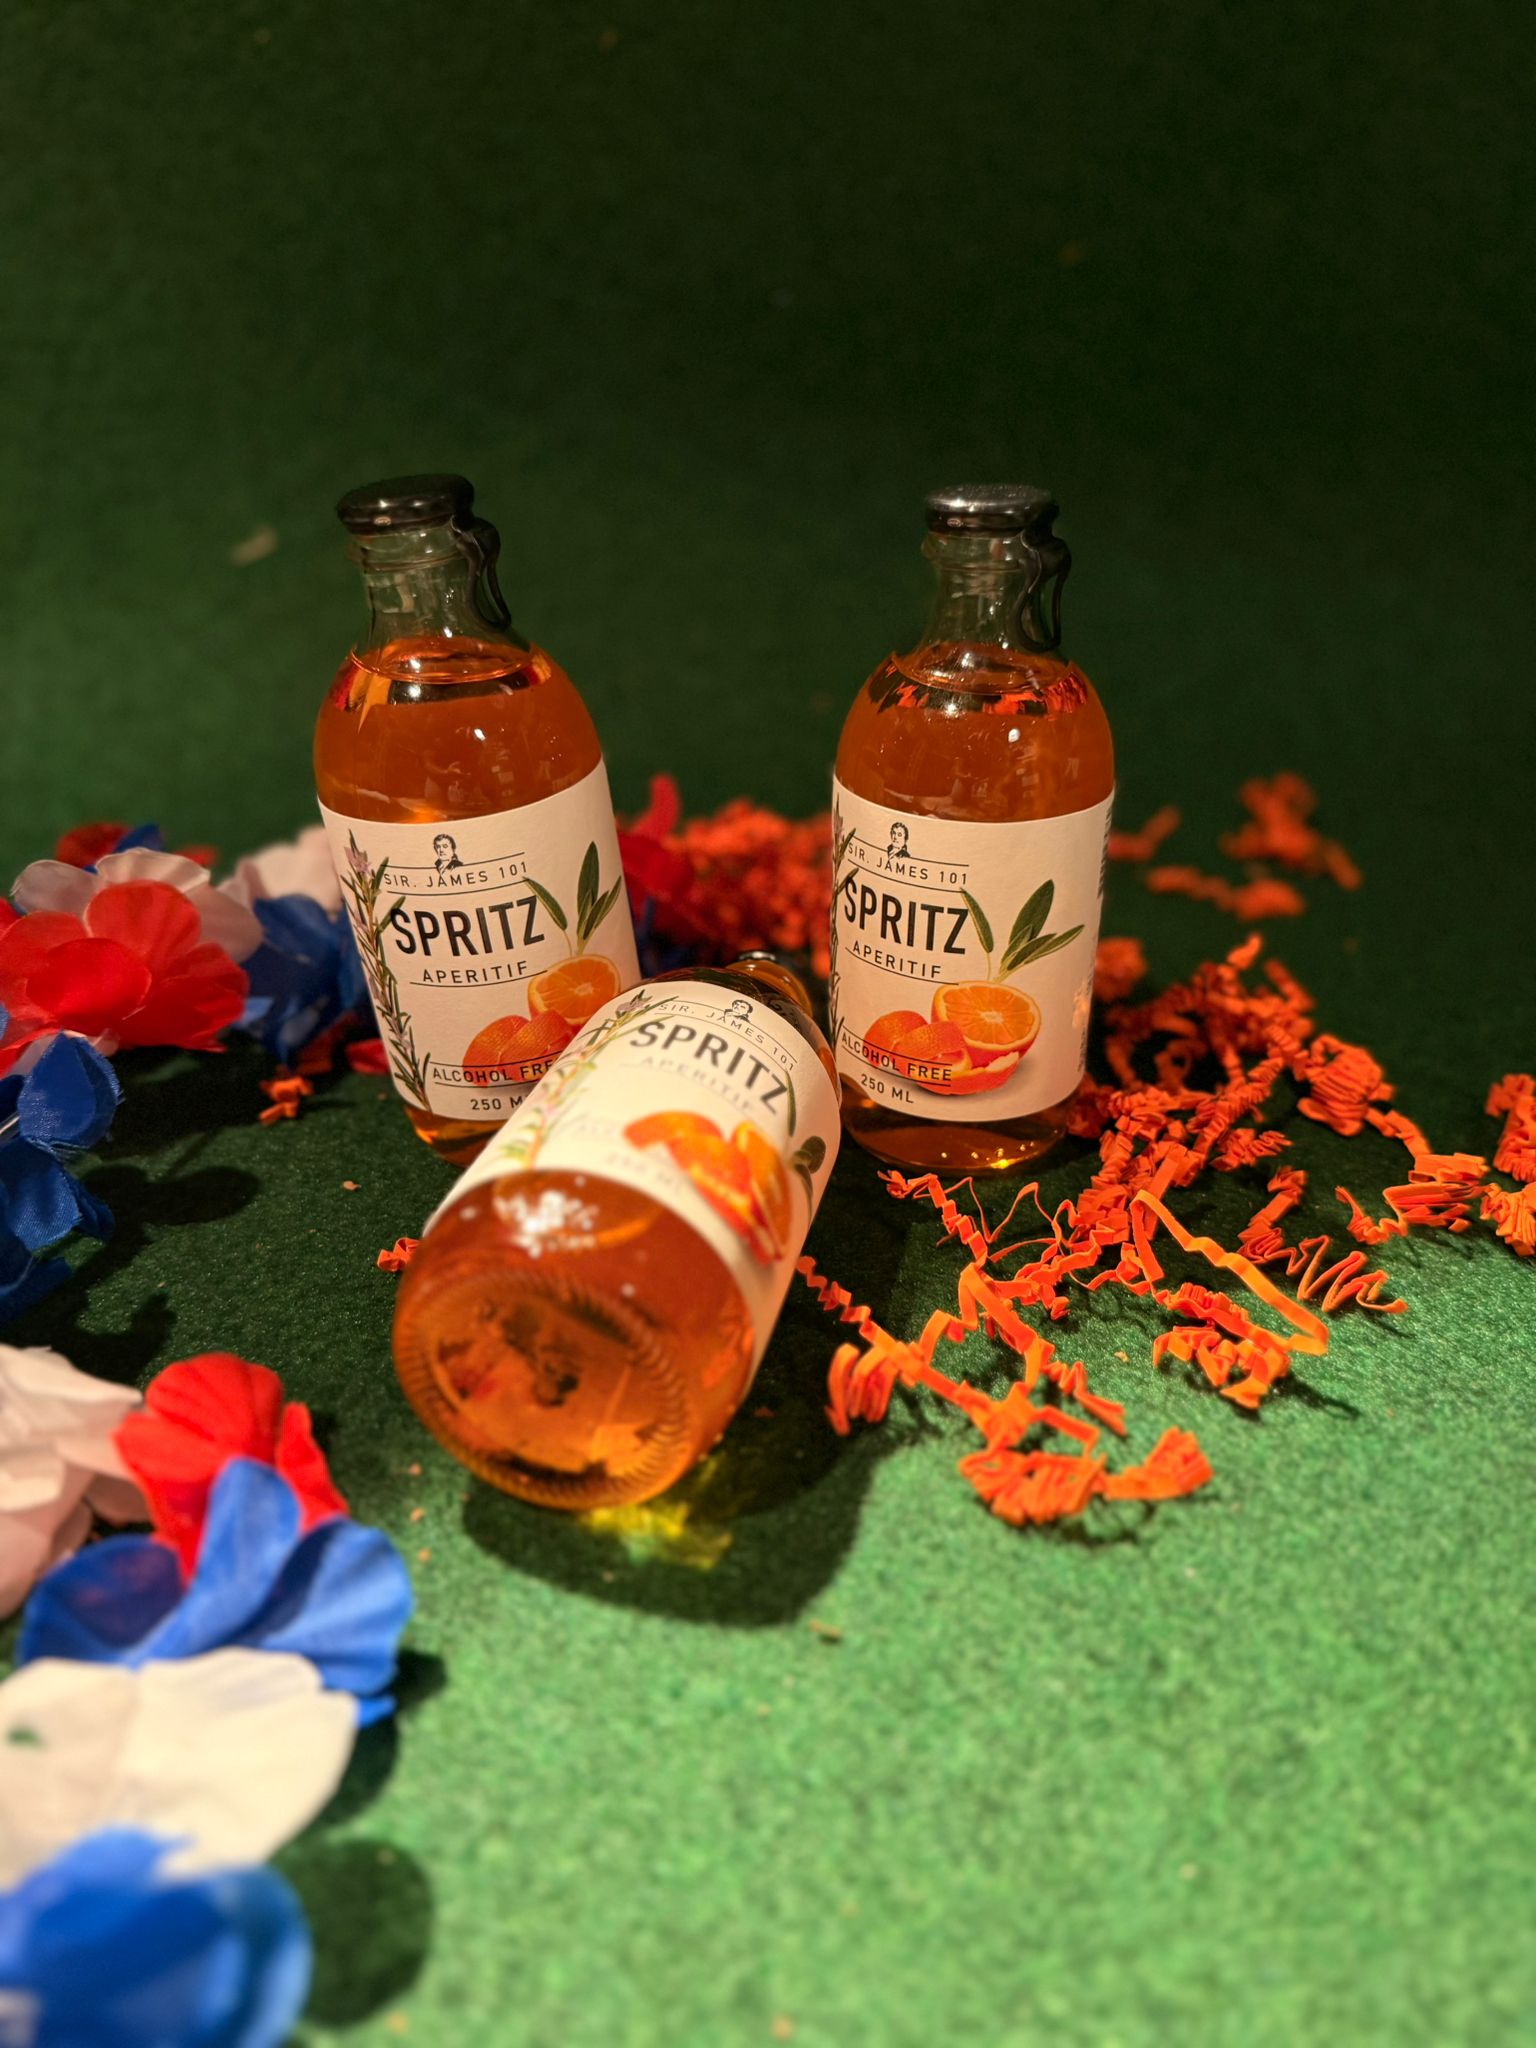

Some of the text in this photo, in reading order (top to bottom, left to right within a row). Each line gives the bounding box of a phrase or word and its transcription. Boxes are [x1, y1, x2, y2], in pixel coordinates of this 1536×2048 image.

[384, 861, 528, 889] SIR. JAMES 101
[848, 841, 968, 886] SIR. JAMES 101
[389, 894, 546, 957] SPRITZ
[843, 875, 970, 956] SPRITZ
[422, 960, 529, 984] APERITIF
[852, 940, 942, 979] APERITIF
[657, 1002, 795, 1072] SIR. JAMES 101
[841, 1030, 953, 1082] ALCOHOL FREE
[432, 1057, 558, 1084] ALCOHOL FRE
[629, 1021, 788, 1115] SPRITZ
[860, 1073, 915, 1104] 250 ML
[470, 1095, 527, 1111] 250 M
